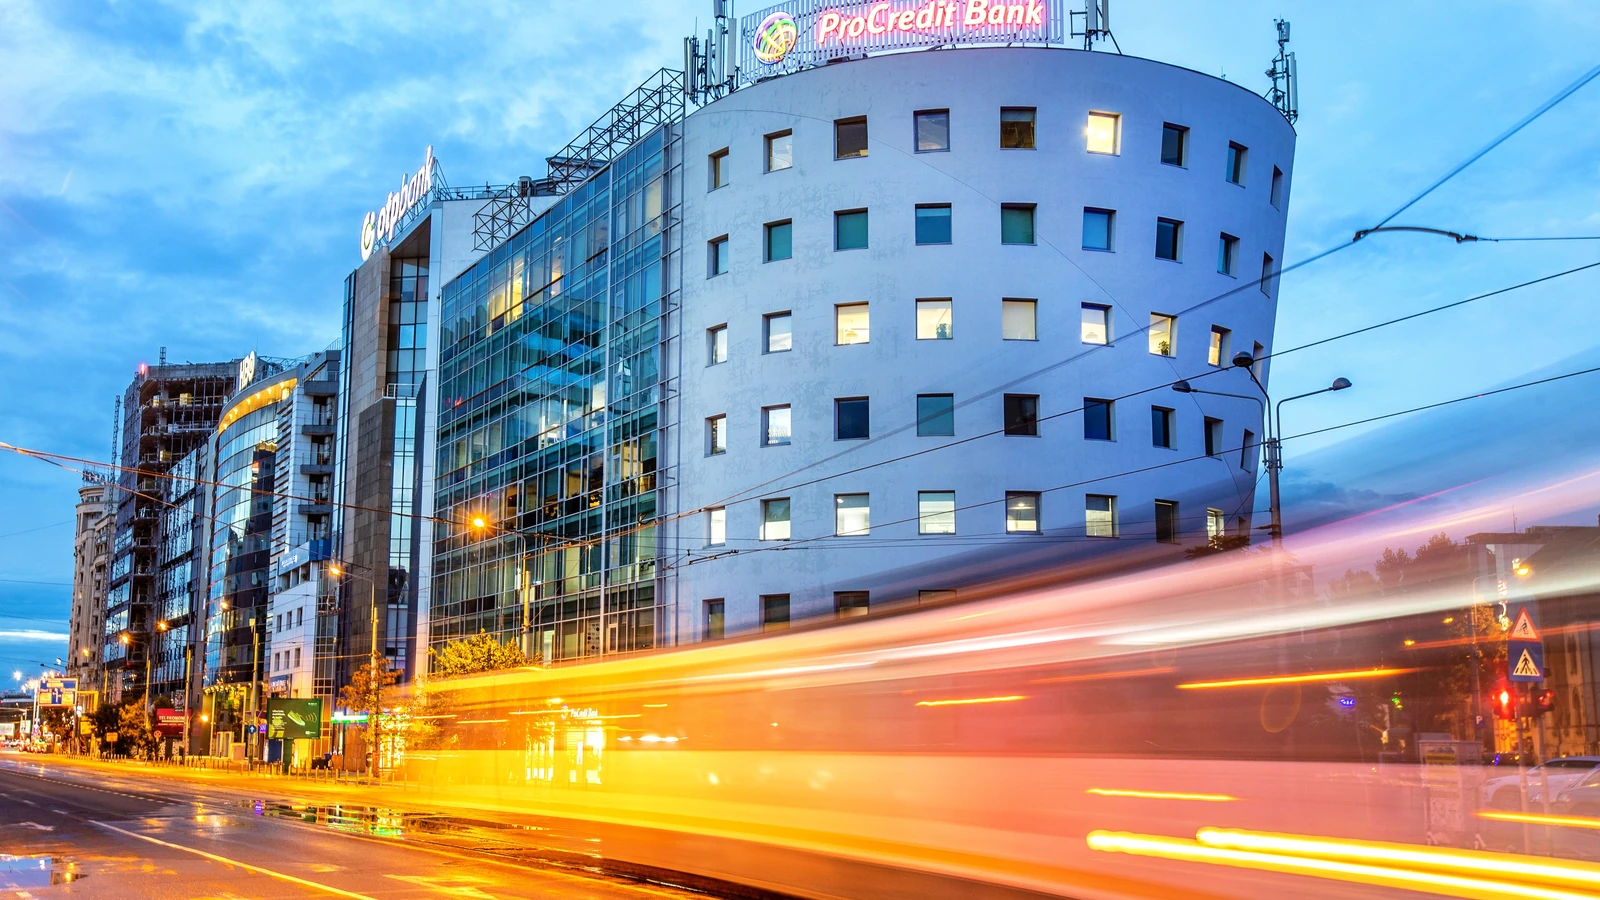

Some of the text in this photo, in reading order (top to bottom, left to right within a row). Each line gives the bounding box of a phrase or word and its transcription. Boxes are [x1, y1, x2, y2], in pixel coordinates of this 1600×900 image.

[818, 0, 1044, 44] ProCredit Bank
[377, 145, 435, 242] otpbank
[239, 350, 255, 391] HBO
[1475, 715, 1484, 725] P
